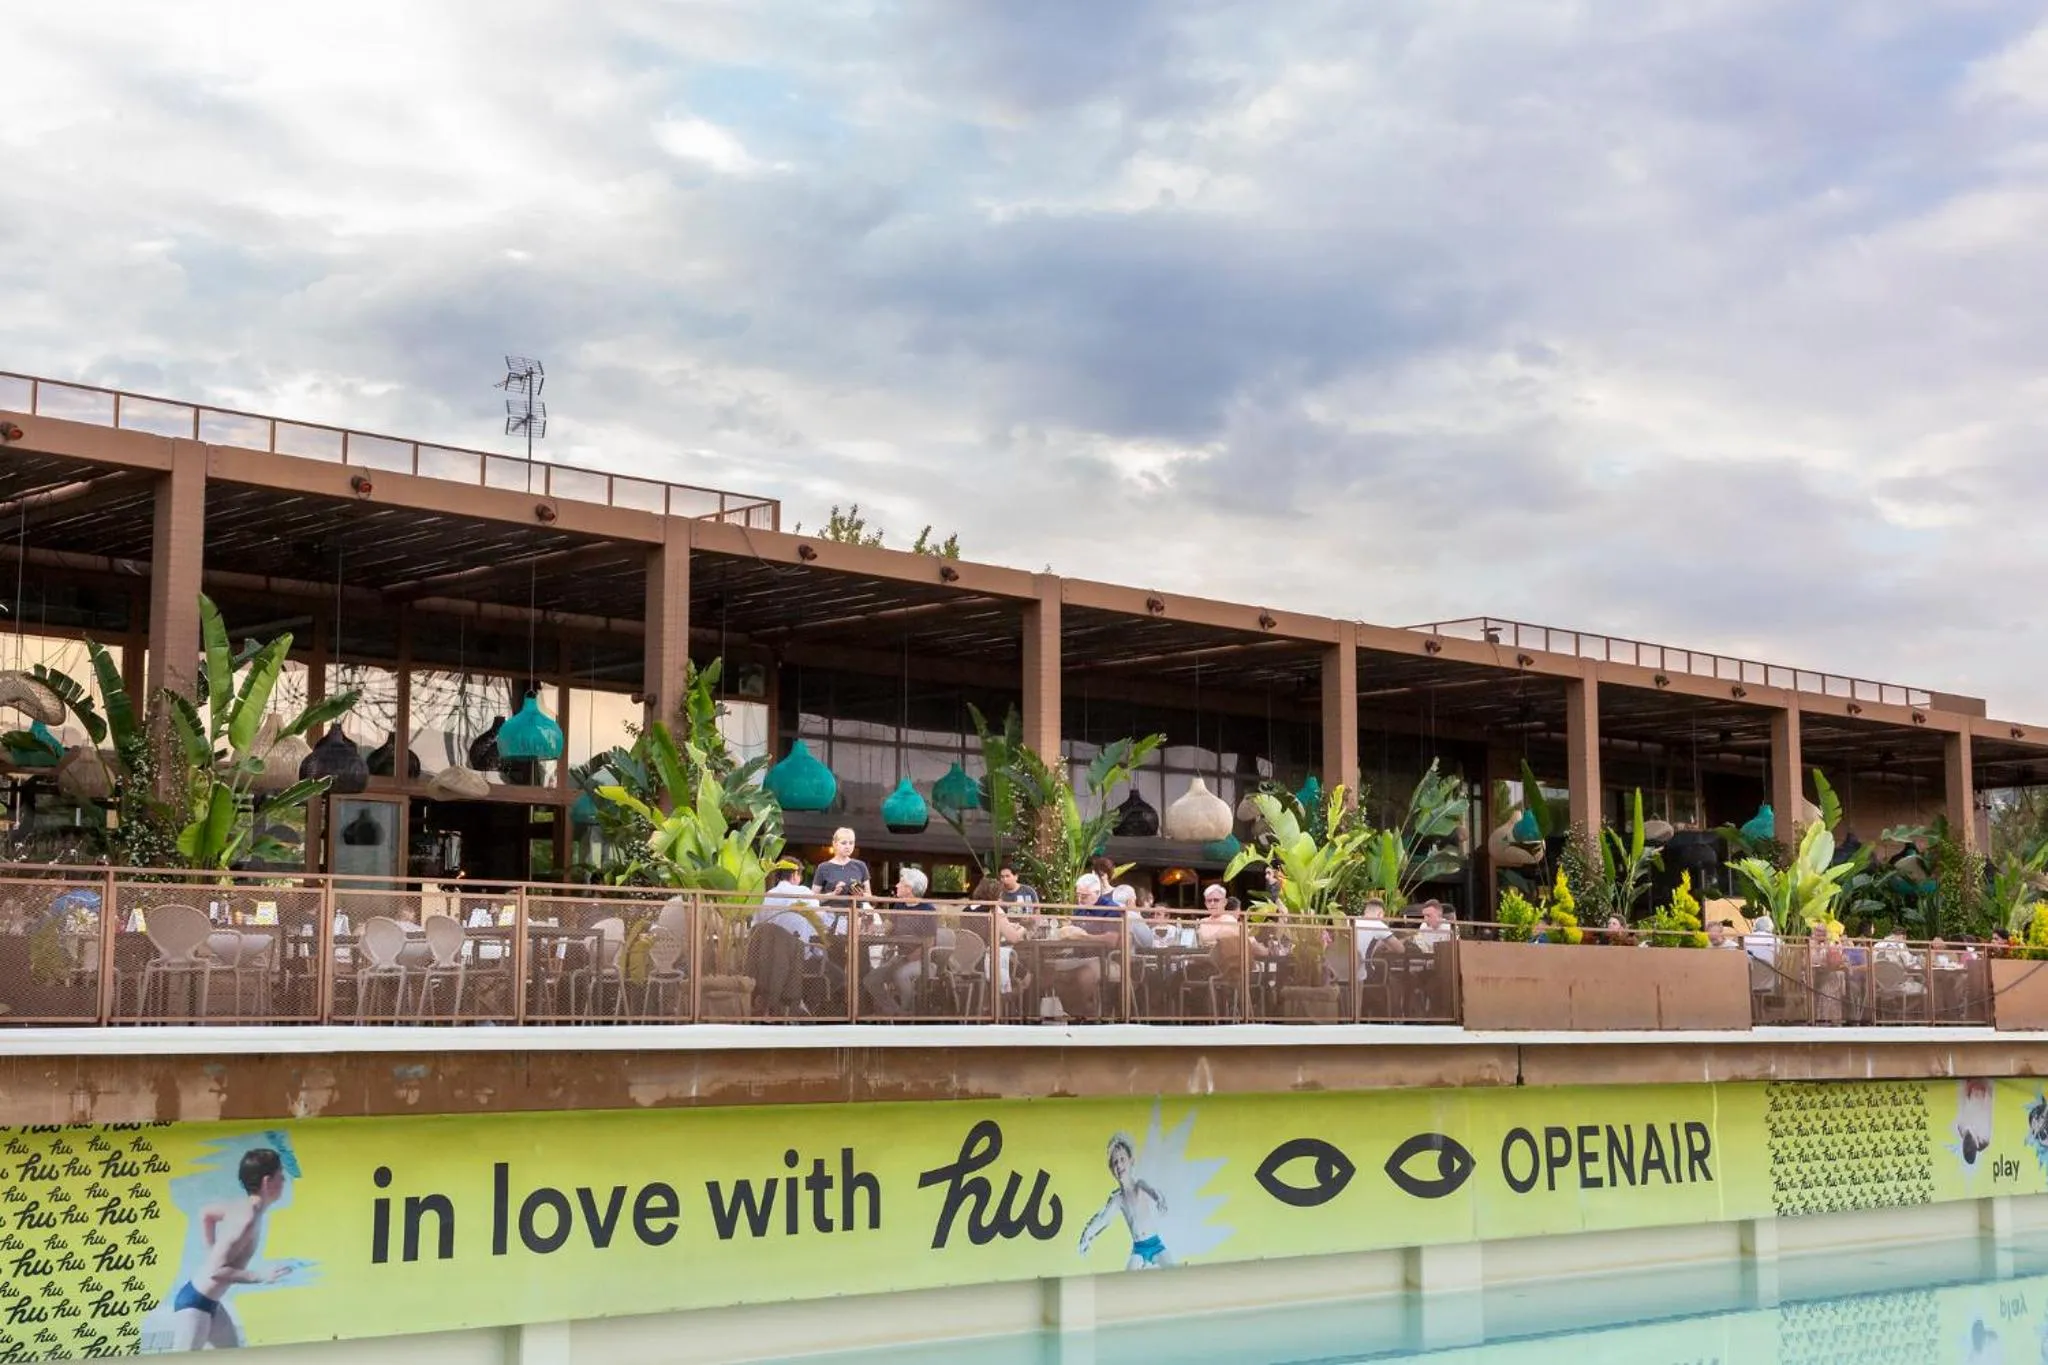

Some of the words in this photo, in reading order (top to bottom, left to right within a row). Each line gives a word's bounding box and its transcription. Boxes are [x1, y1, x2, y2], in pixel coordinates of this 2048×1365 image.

[1501, 1122, 1714, 1194] OPENAIR
[1993, 1153, 2020, 1183] play
[372, 1165, 455, 1264] in
[493, 1163, 680, 1256] love
[706, 1148, 881, 1240] with
